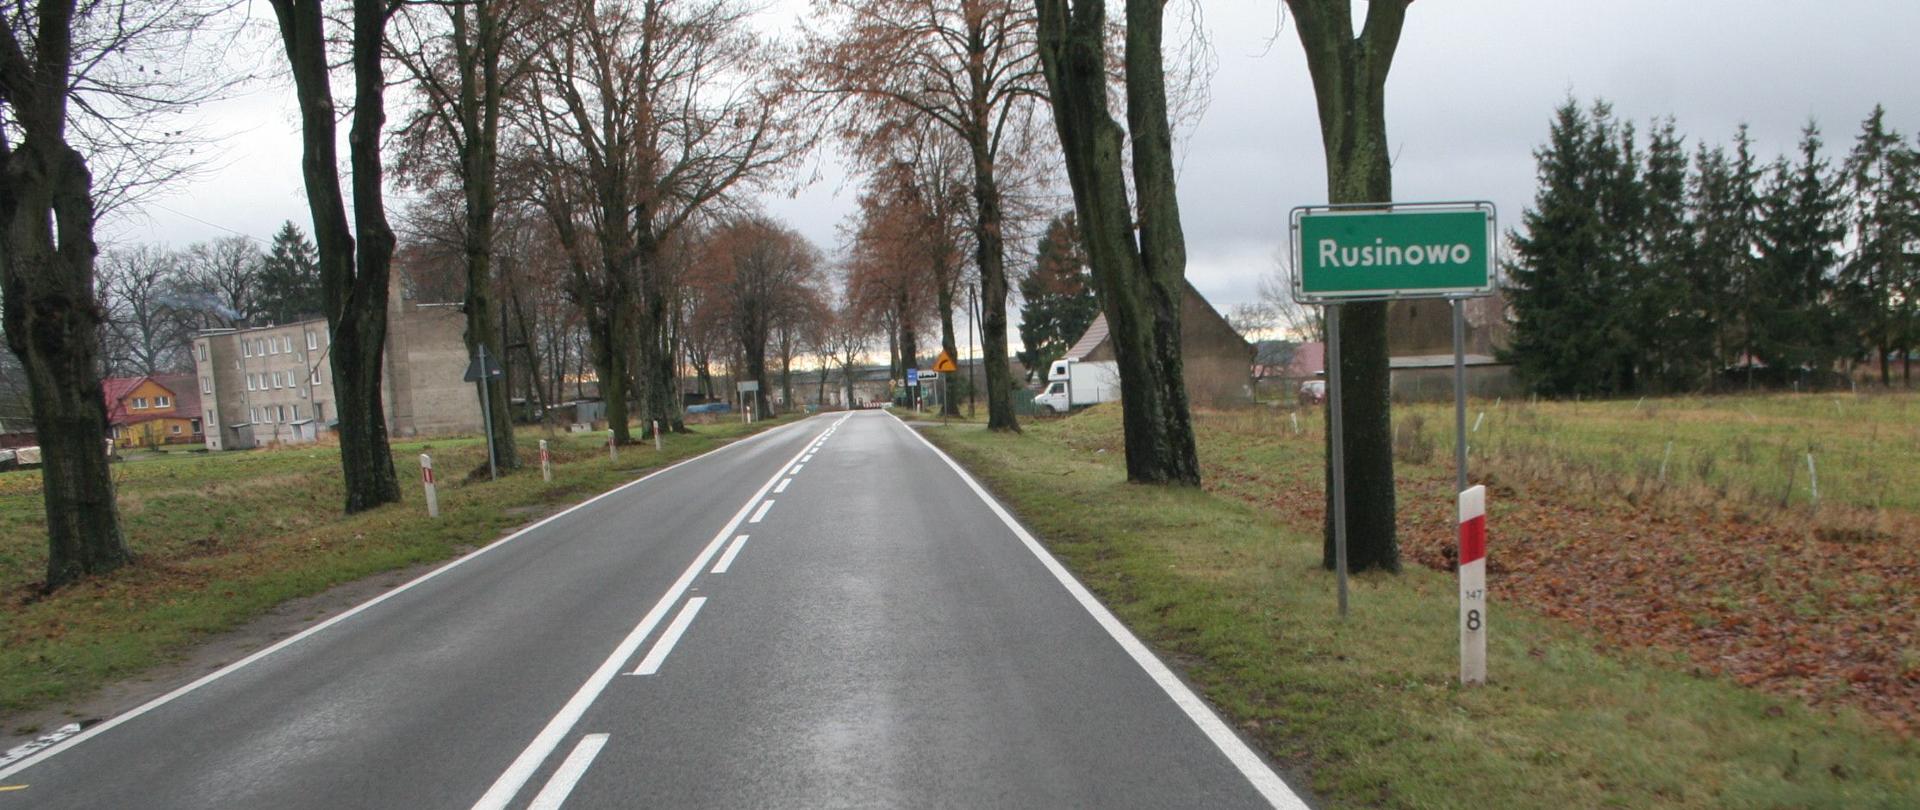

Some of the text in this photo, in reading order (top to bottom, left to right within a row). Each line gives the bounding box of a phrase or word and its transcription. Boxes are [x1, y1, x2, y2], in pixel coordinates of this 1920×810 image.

[1319, 238, 1470, 267] Rusinowo
[1466, 590, 1482, 600] 147
[1467, 609, 1480, 631] 8
